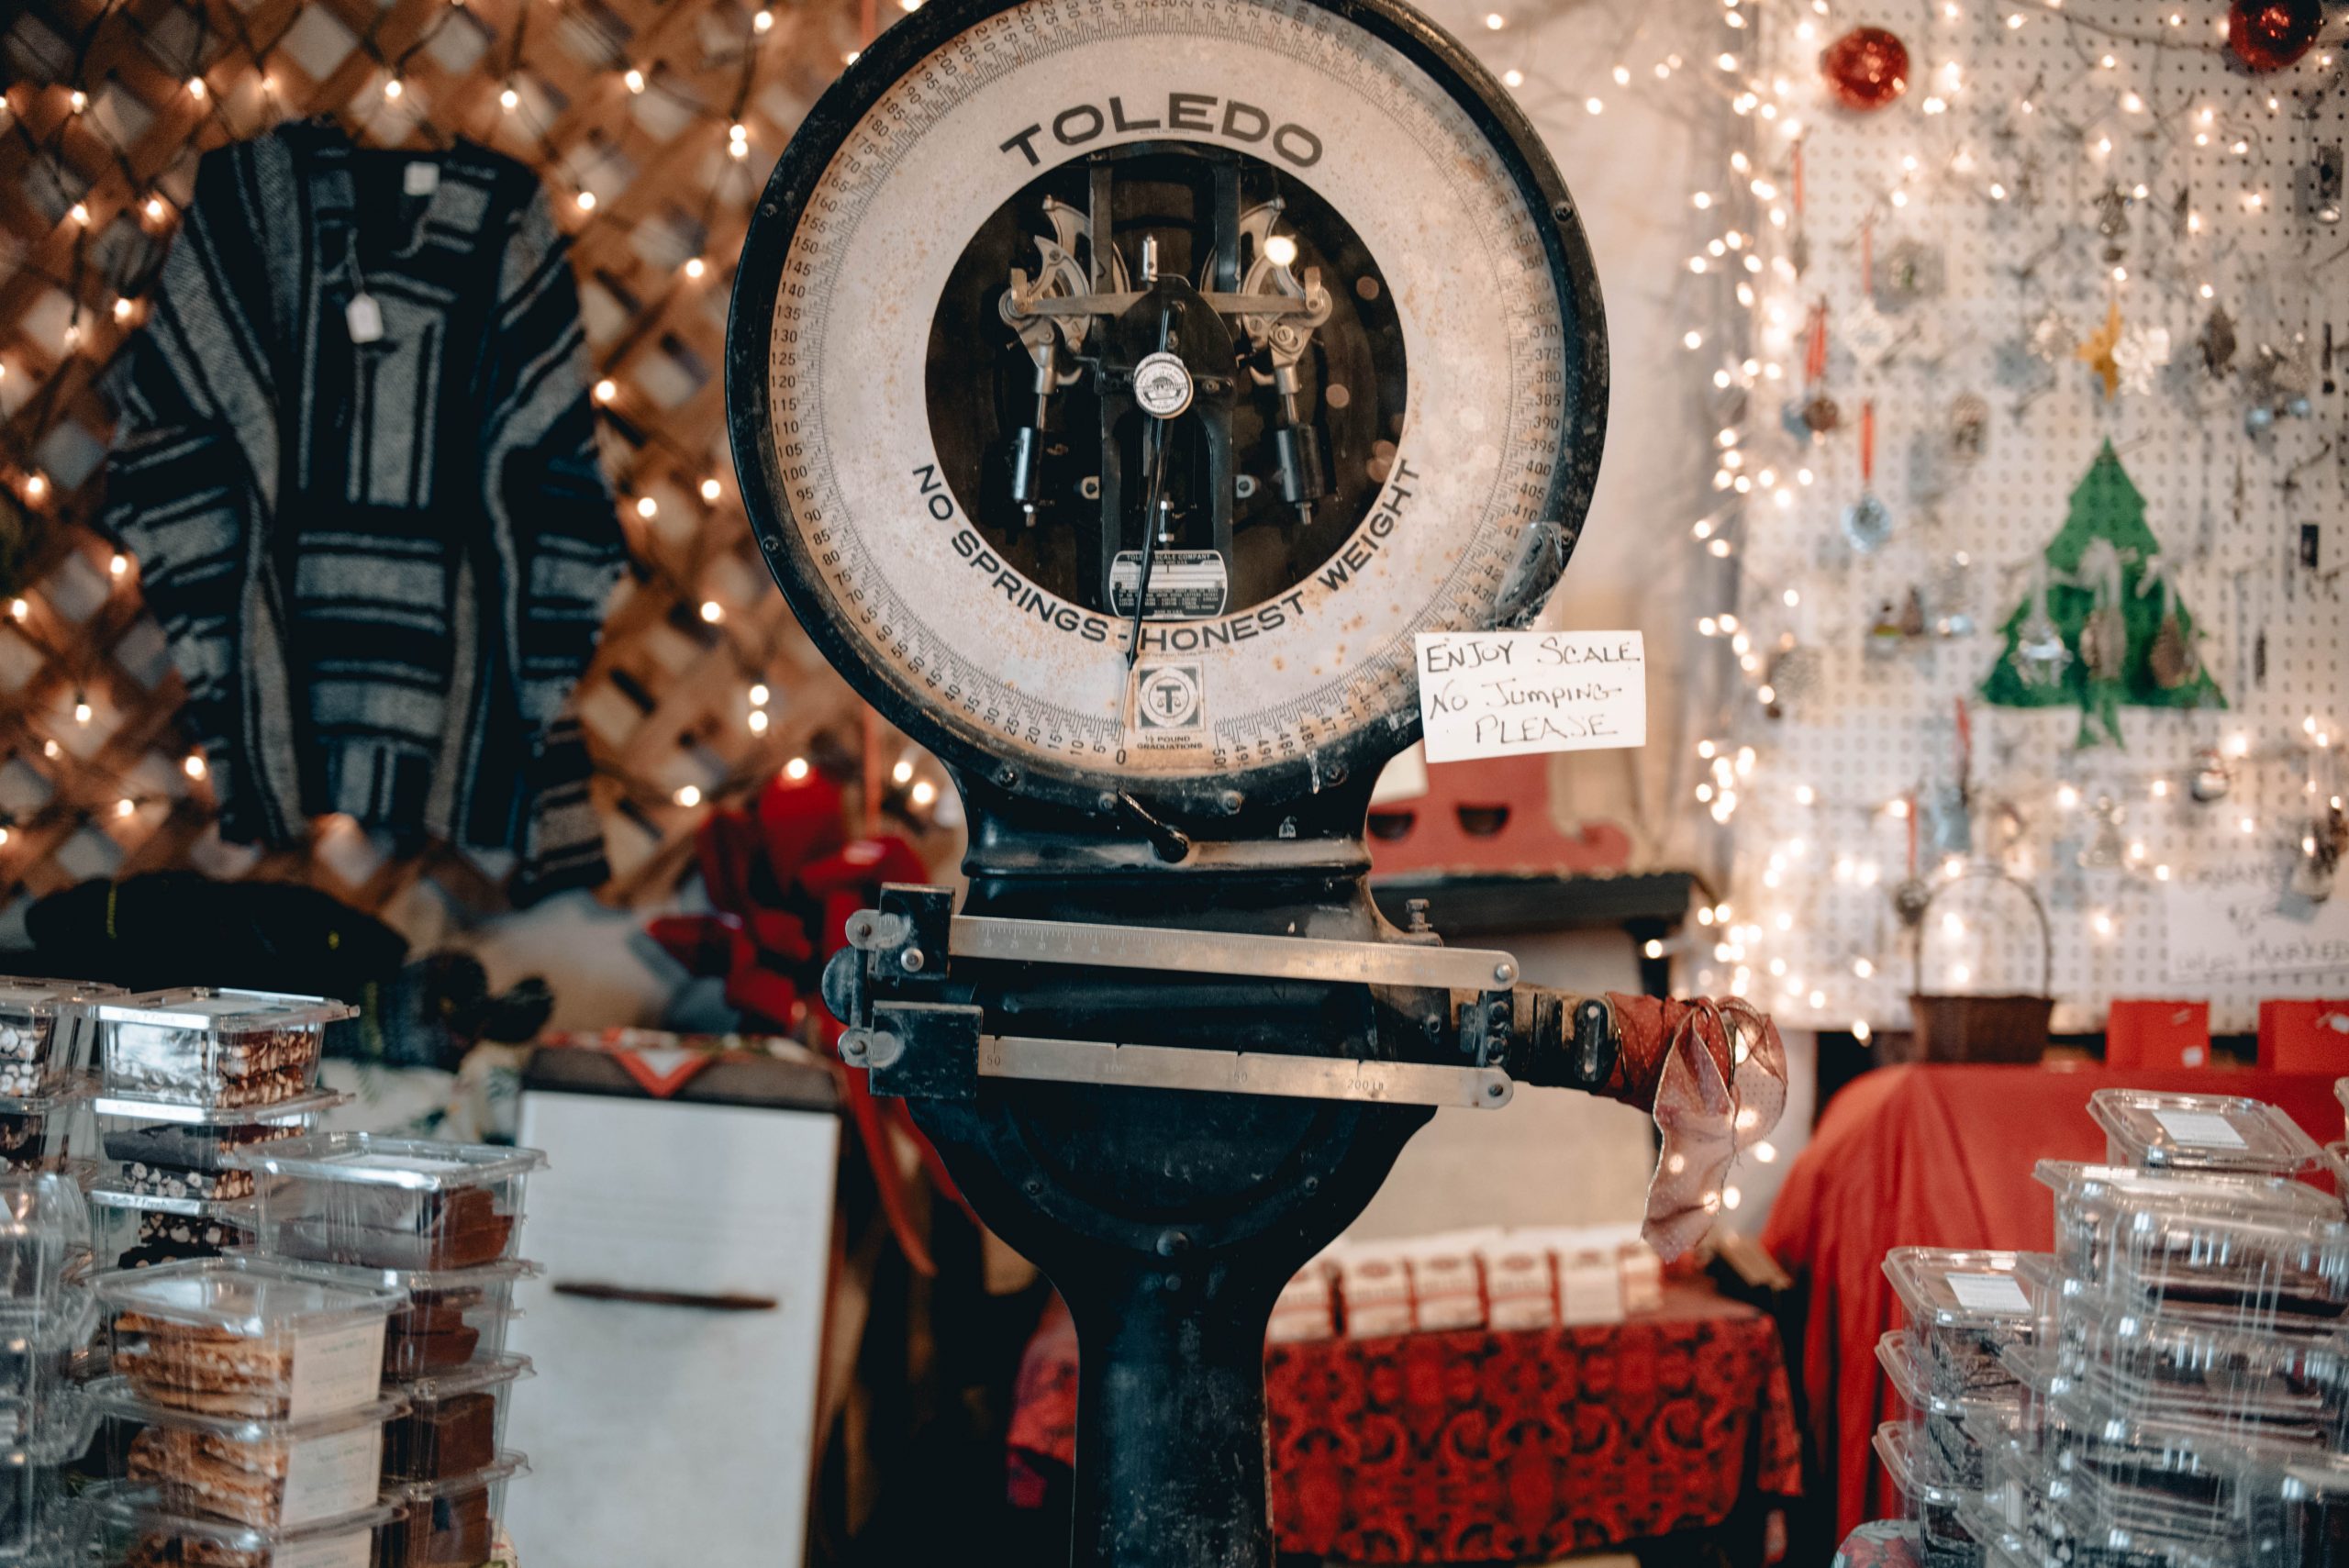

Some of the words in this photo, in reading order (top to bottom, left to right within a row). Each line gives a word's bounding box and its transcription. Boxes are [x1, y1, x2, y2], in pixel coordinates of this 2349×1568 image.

[995, 14, 1016, 43] 215
[1017, 6, 1036, 34] 220
[974, 25, 996, 53] 210
[952, 37, 975, 64] 205
[933, 50, 956, 77] 200
[914, 64, 939, 91] 195
[896, 80, 921, 106] 190
[879, 95, 905, 122] 185
[863, 114, 889, 139] 180
[1000, 93, 1323, 168] TOLEDO
[848, 132, 874, 156] 175
[834, 151, 862, 174] 170
[821, 172, 849, 194] 165
[810, 192, 838, 213] 160
[800, 214, 828, 234] 155
[792, 236, 819, 255] 150
[785, 259, 812, 276] 145
[779, 282, 807, 298] 140
[774, 305, 802, 320] 135
[772, 328, 798, 342] 130
[771, 352, 796, 364] 125
[770, 376, 796, 387] 120
[771, 398, 796, 411] 115
[774, 420, 799, 434] 110
[776, 443, 803, 458] 105
[782, 464, 807, 481] 100
[796, 486, 814, 502] 95
[803, 507, 822, 523] 90
[811, 528, 830, 545] 85
[821, 549, 841, 565] 80
[912, 463, 953, 522] NO
[952, 529, 1109, 643] SPRINGS
[1141, 590, 1308, 652] HONEST
[1318, 458, 1420, 595] WEIGHT
[832, 568, 852, 585] 75
[845, 587, 864, 606] 70
[859, 605, 878, 624] 65
[874, 622, 893, 641] 60
[889, 639, 908, 658] 55
[1427, 639, 1514, 673] ENJOY
[1537, 636, 1642, 666] SCALE
[906, 654, 925, 674] 50
[923, 669, 942, 689] 45
[942, 683, 961, 702] 40
[1156, 684, 1182, 715] T
[962, 695, 979, 715] 35
[982, 706, 999, 726] 30
[1003, 717, 1019, 735] 25
[1025, 725, 1040, 743] 20
[1475, 714, 1618, 744] PLEASE
[1047, 733, 1062, 751] 15
[1069, 739, 1083, 756] 10
[1093, 744, 1105, 754] 5
[1116, 749, 1127, 765] 0
[986, 1055, 1001, 1066] 50
